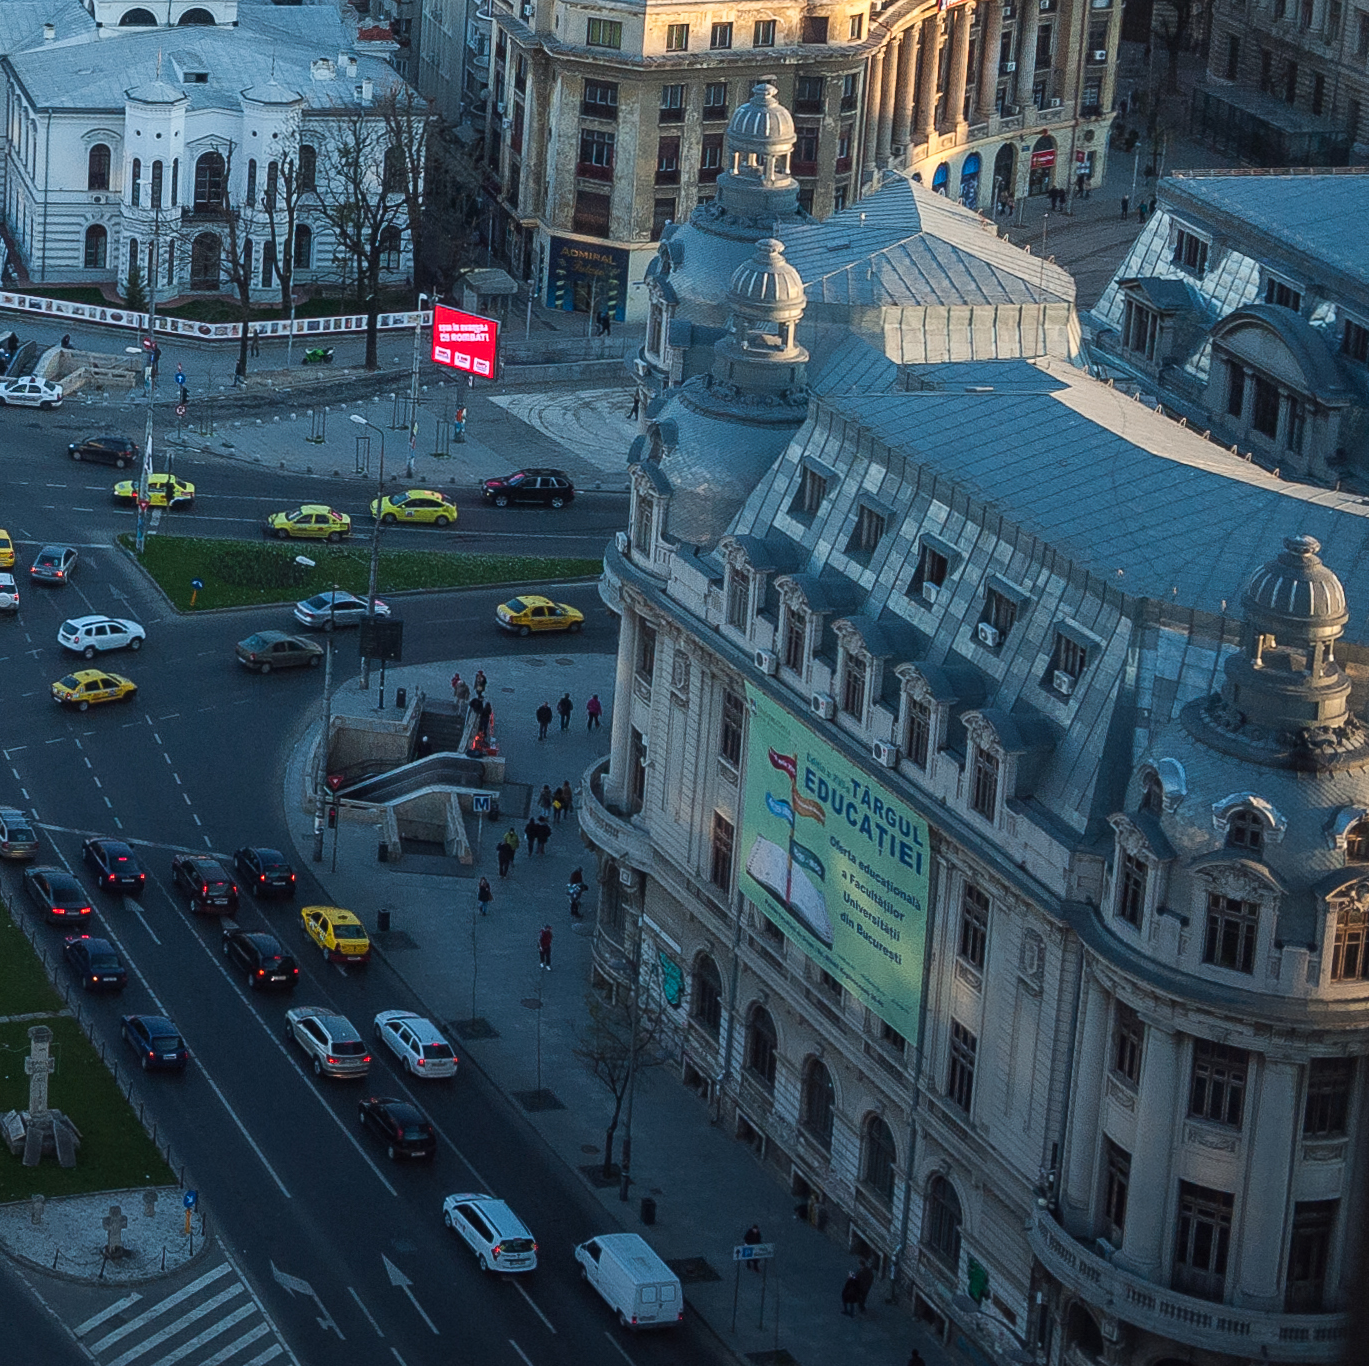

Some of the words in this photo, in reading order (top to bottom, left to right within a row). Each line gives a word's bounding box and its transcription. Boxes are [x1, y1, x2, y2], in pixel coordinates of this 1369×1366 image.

[560, 246, 617, 265] ADMIRAL
[804, 767, 922, 875] EDUCAȚIEI
[851, 777, 923, 848] TÂRGUL
[830, 836, 857, 864] Oferta
[859, 860, 921, 911] educațională
[840, 912, 854, 929] din
